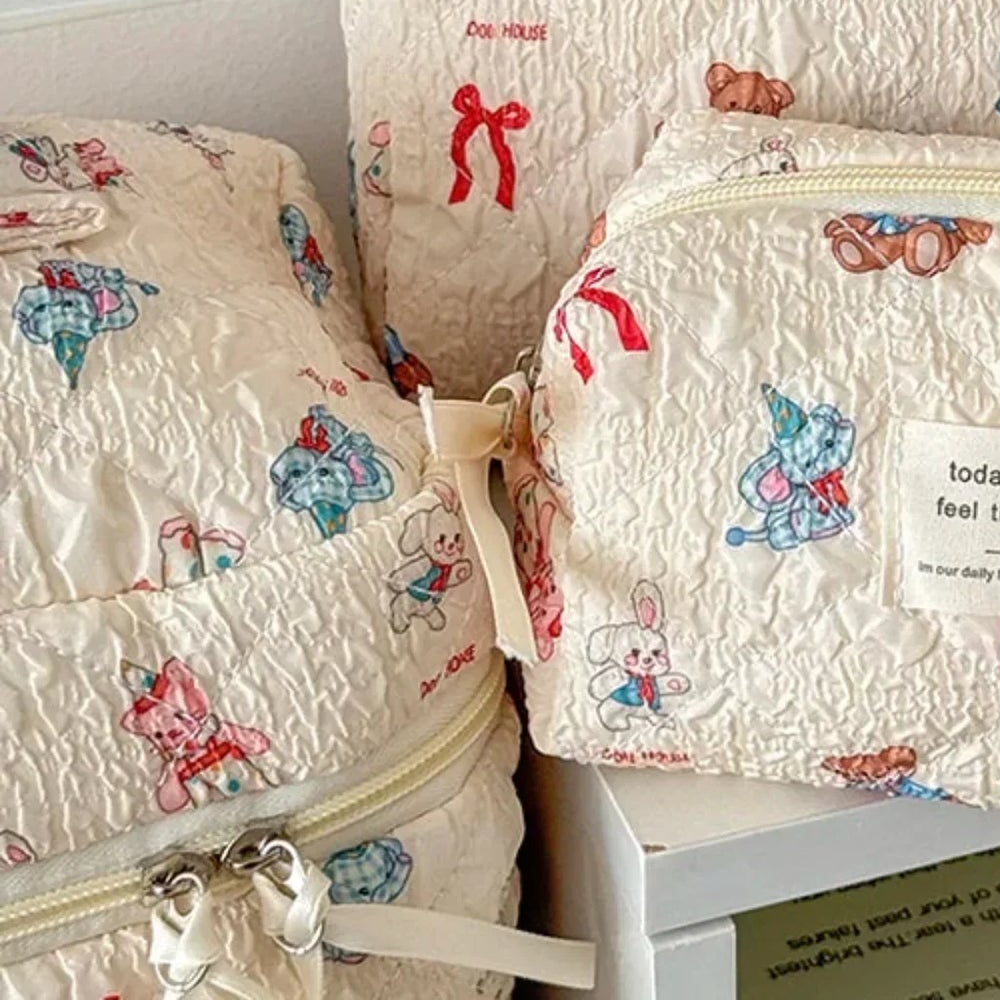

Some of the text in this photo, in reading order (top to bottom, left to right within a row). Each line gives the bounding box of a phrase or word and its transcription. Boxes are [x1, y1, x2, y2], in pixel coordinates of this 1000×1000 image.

[936, 496, 979, 520] feel
[936, 564, 959, 576] our
[961, 566, 995, 583] daily
[919, 893, 964, 917] your
[968, 888, 992, 907] of
[865, 907, 913, 932] past
[958, 914, 975, 927] a
[767, 944, 864, 980] brightest
[948, 976, 1000, 998] have
